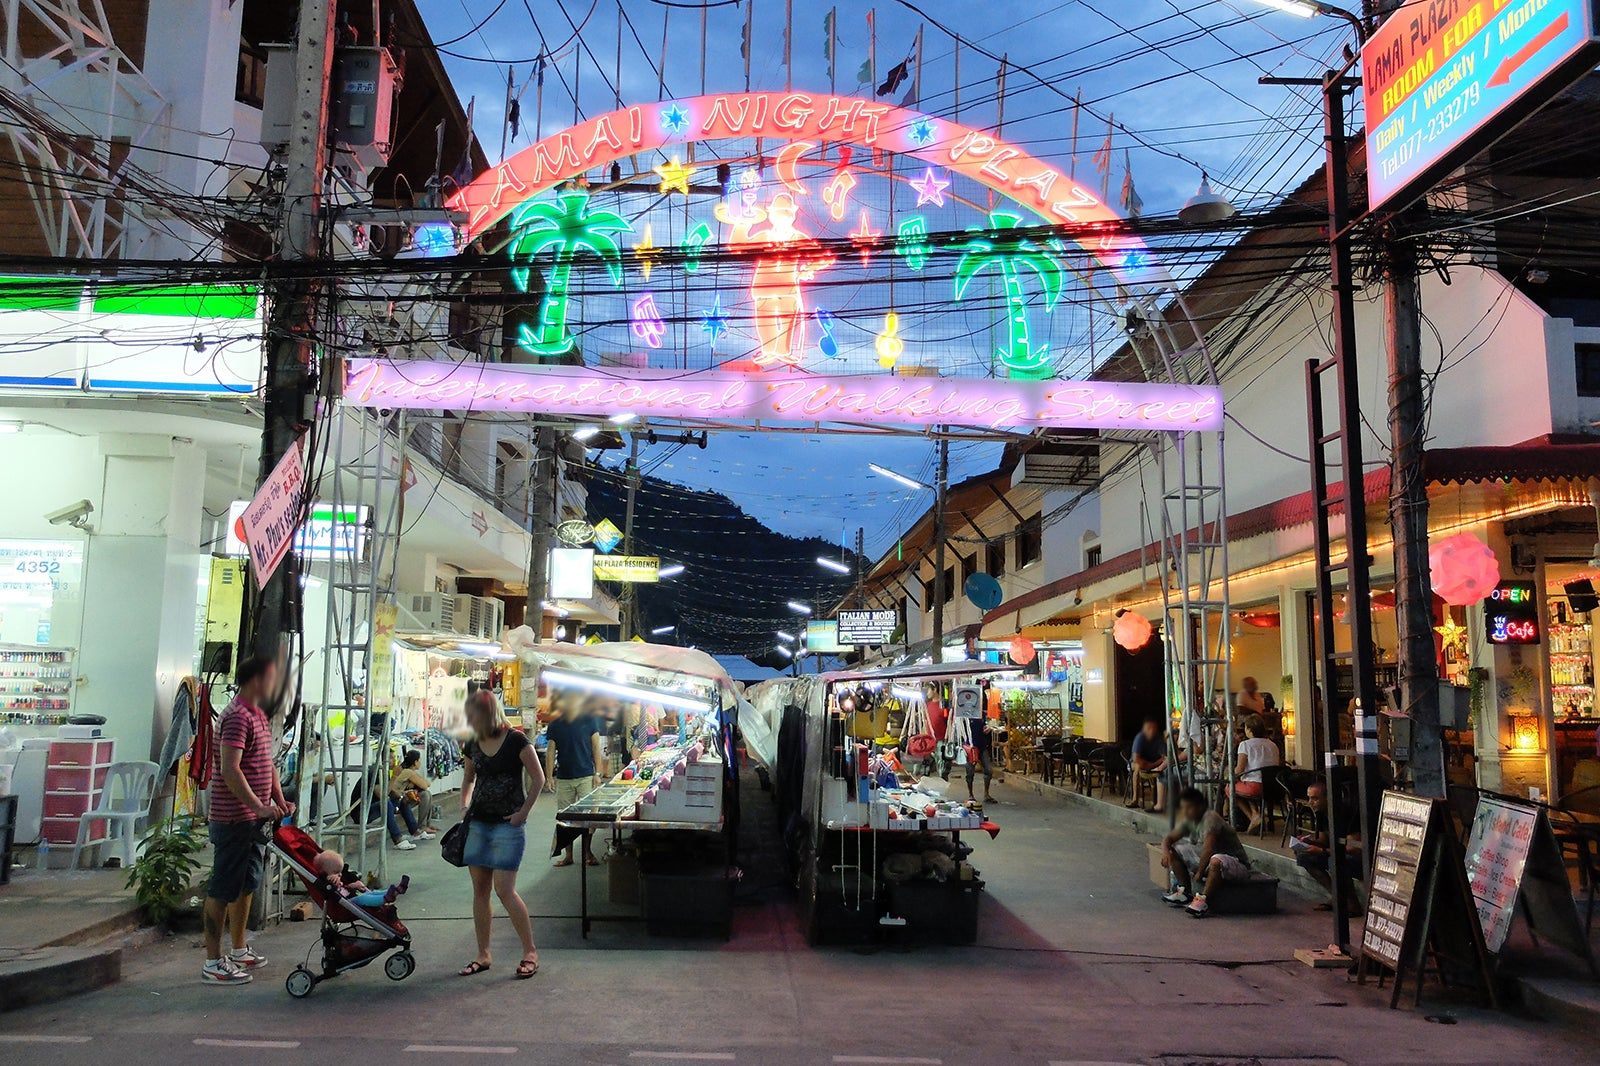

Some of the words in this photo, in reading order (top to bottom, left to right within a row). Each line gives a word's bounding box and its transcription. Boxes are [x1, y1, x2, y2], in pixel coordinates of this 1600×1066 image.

[1368, 34, 1404, 96] LAMAI
[1382, 47, 1434, 115] ROOM
[1443, 3, 1481, 58] FOR
[1375, 116, 1405, 153] Daily
[1423, 52, 1475, 109] Weekly
[1381, 81, 1480, 180] Tel.077-233279
[453, 106, 642, 232] LAMAI
[702, 93, 889, 143] NIGHT
[949, 130, 1114, 249] PLAZ
[345, 361, 749, 411] International
[767, 380, 1027, 428] Walking
[1036, 387, 1217, 422] Street
[16, 561, 60, 573] 4352
[254, 540, 270, 571] Mr.
[625, 560, 658, 569] RESIDENCE
[839, 611, 870, 620] ITALIAN
[872, 610, 896, 620] MODE
[1491, 589, 1530, 601] OPEN
[1507, 621, 1534, 639] Café
